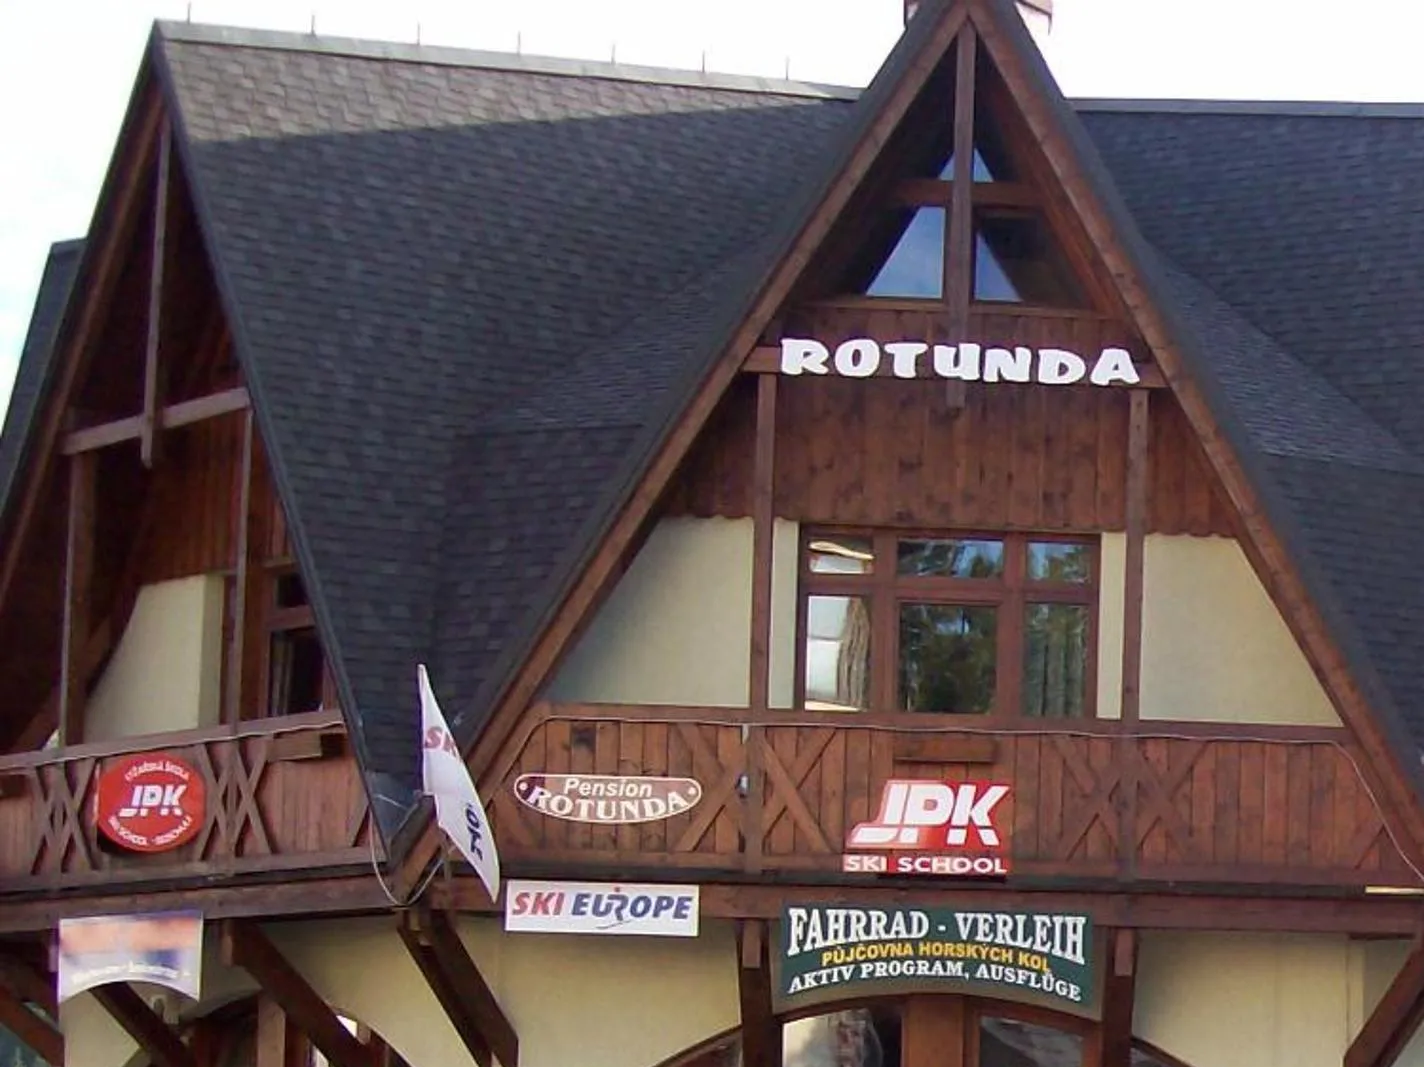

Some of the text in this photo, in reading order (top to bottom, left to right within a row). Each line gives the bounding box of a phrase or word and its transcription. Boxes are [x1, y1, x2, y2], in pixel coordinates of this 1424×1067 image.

[780, 337, 1141, 386] ROTUNDA
[119, 784, 187, 817] JPK
[527, 786, 690, 820] ROTUNDA
[564, 777, 653, 798] Pension
[852, 783, 1010, 846] JPK
[844, 855, 1008, 874] SKI SCHOOL
[512, 892, 693, 921] SKI EUROPE
[787, 907, 930, 956] FAHRRAD
[955, 911, 1087, 965] VERLEIH
[1018, 950, 1051, 973] KOL
[787, 960, 1081, 1001] AKTIV PROGRAM, AUSFLÜGE
